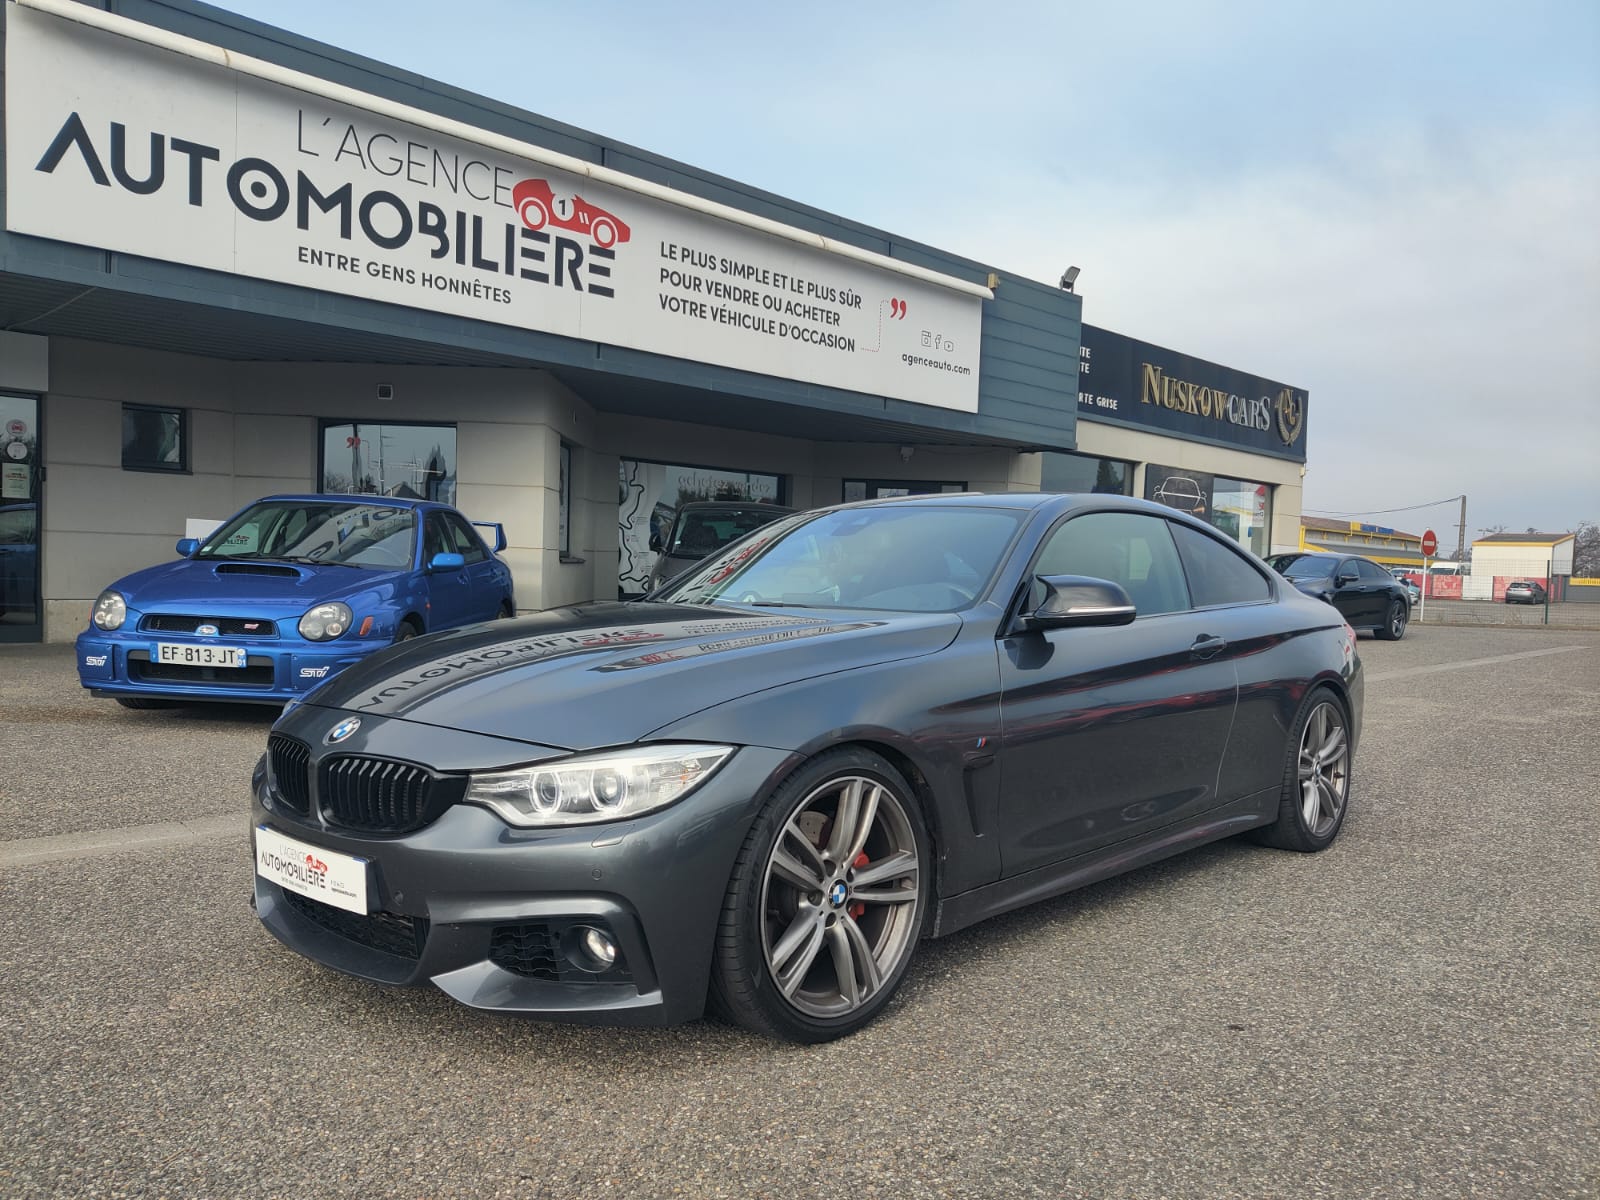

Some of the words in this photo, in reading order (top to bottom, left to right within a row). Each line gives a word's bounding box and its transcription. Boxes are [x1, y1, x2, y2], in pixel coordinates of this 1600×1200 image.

[299, 109, 514, 209] L'AGENCE
[35, 111, 616, 299] AUTOMOBILIERE
[298, 246, 360, 274] ENTRE
[367, 261, 416, 285] GENS
[422, 272, 511, 304] HONNÊTES
[660, 268, 702, 293] POUR
[705, 280, 760, 307] VENDRE
[763, 294, 782, 312] OU
[785, 300, 841, 327] ACHETER
[661, 241, 678, 260] LE
[682, 247, 717, 270] PLUS
[720, 258, 770, 285] SIMPLE
[774, 272, 788, 290] ET
[791, 277, 804, 295] LE
[808, 282, 837, 303] PLUS
[839, 288, 862, 310] SÛR
[659, 293, 707, 320] VOTRE
[710, 303, 776, 335] VÉHICULE
[779, 322, 855, 353] D'OCCASION
[902, 353, 971, 375] agenceauto.com
[1096, 396, 1118, 410] GRISE
[261, 851, 326, 889] AUTOMOBILIERE
